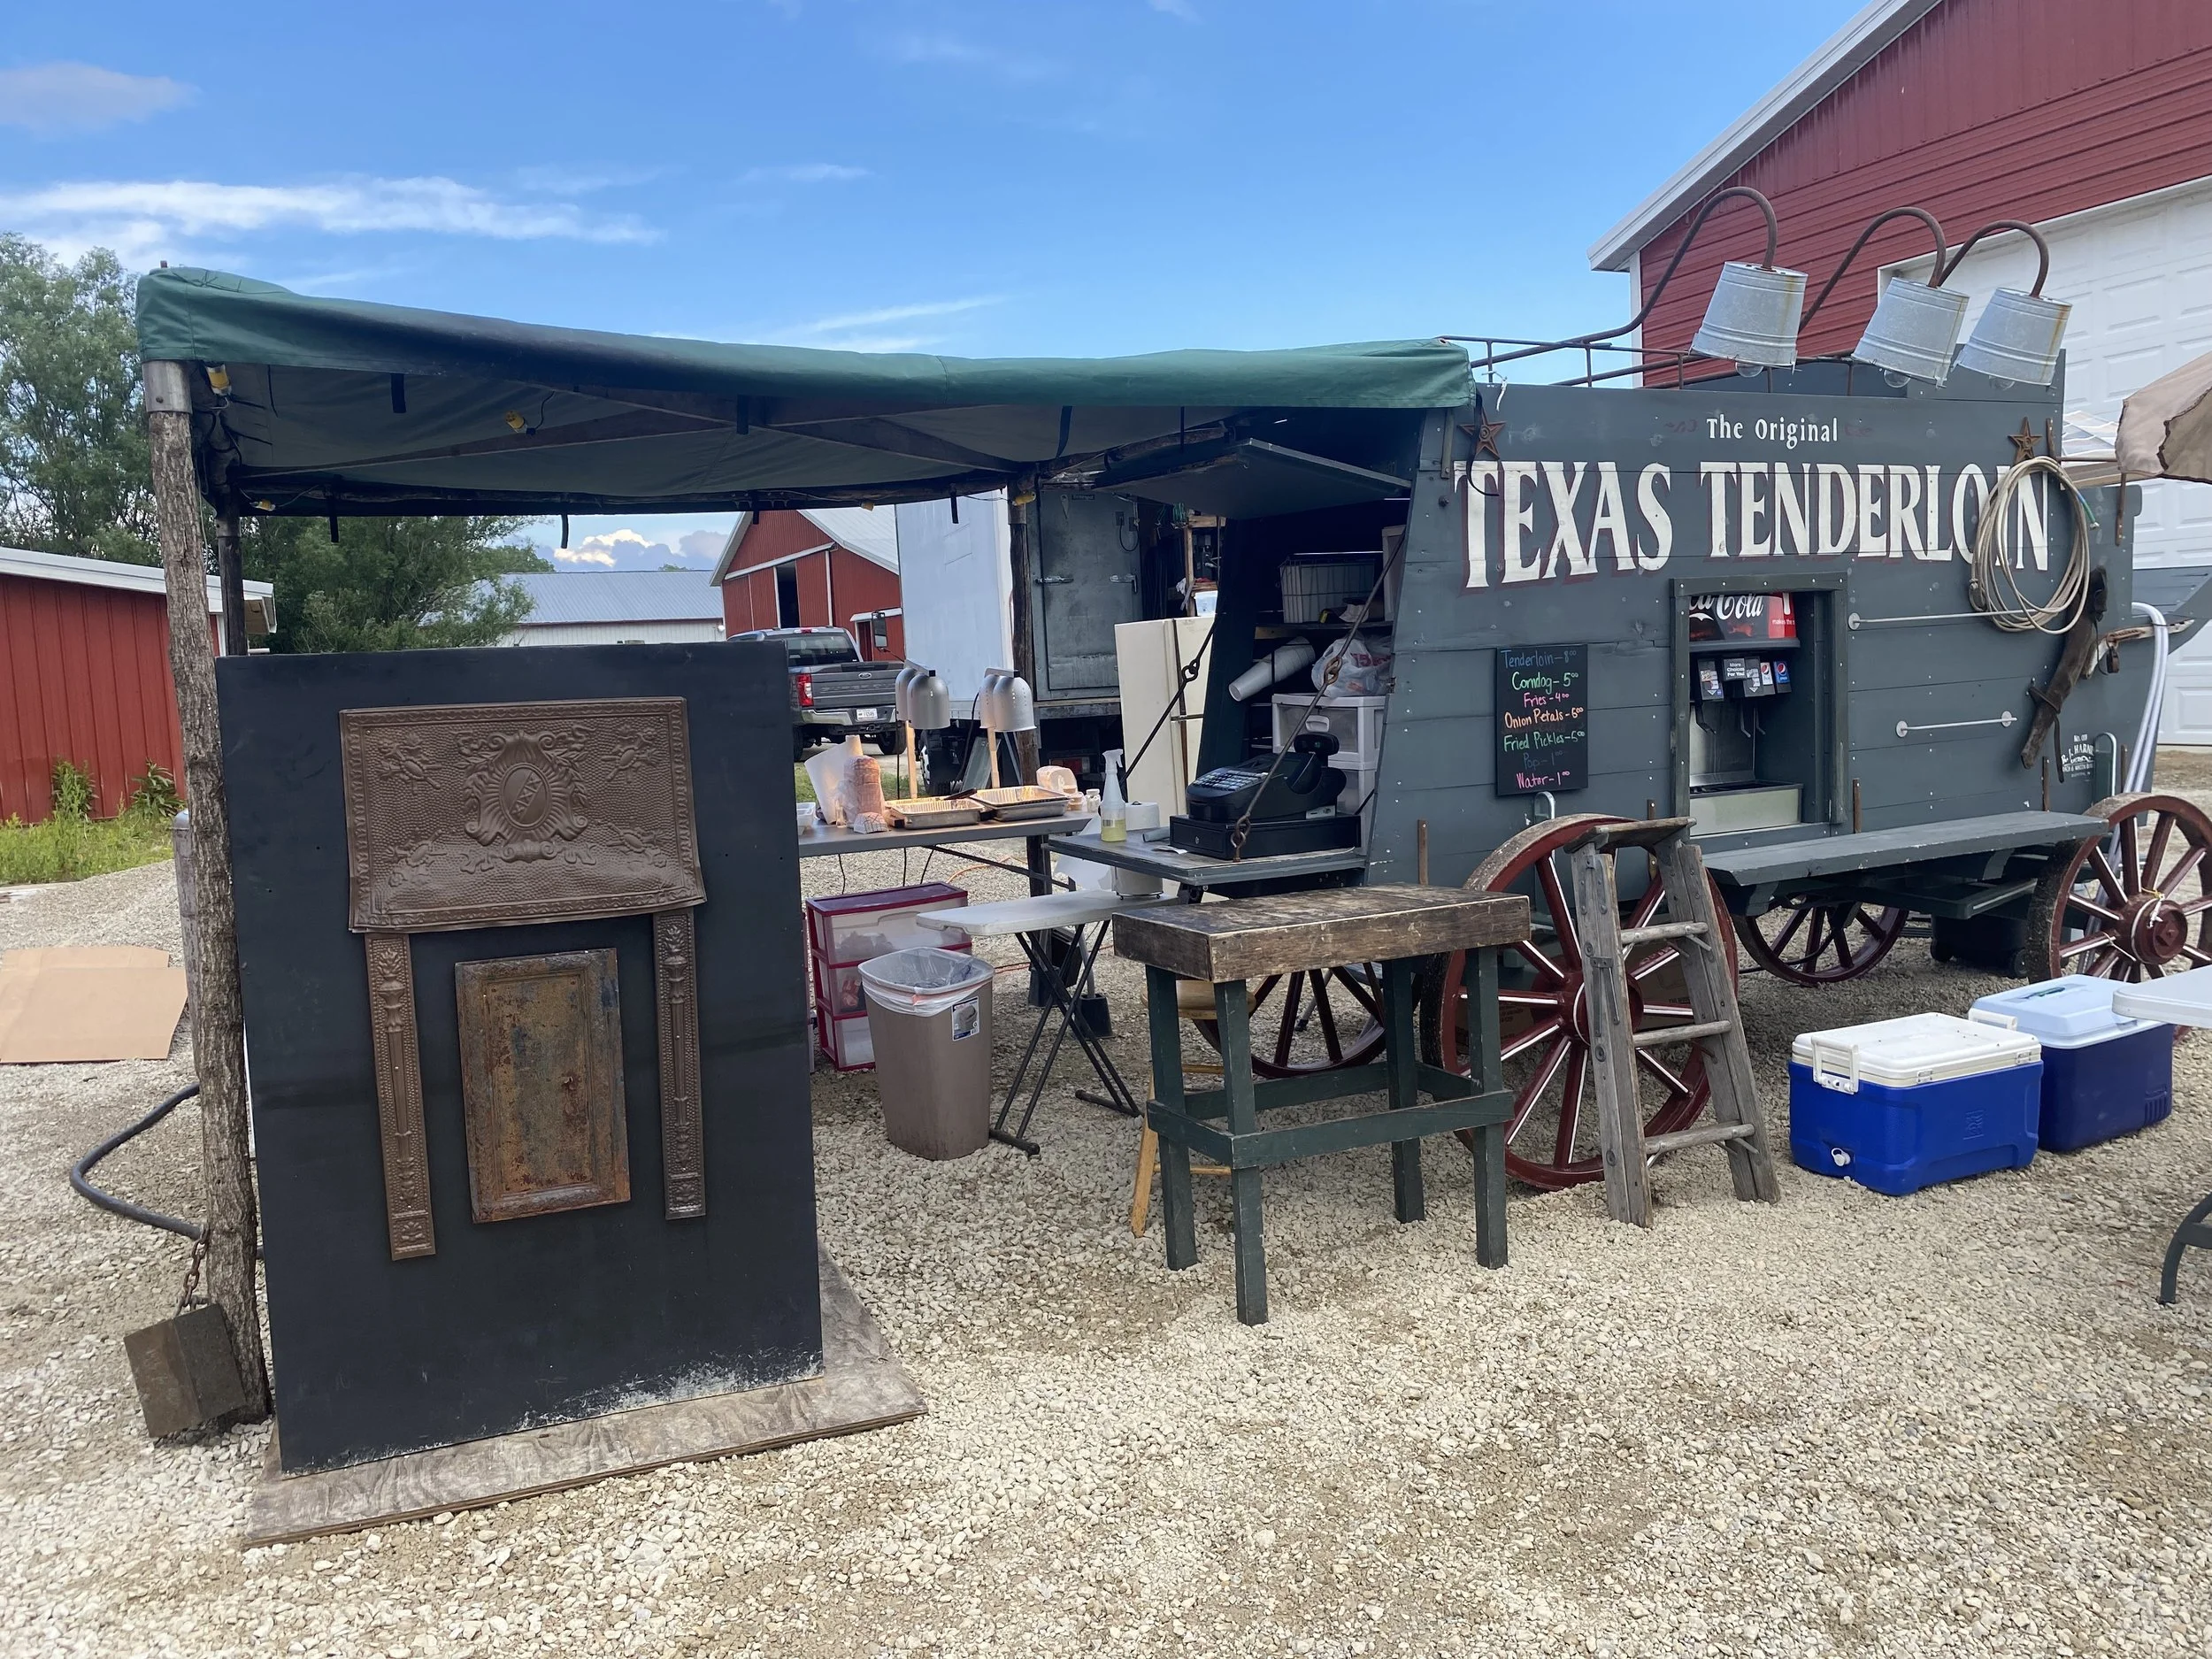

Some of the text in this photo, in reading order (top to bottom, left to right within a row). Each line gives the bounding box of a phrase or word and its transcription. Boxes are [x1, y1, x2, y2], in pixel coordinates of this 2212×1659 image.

[1707, 414, 1838, 449] The Original
[1454, 461, 1671, 588] TEXAS
[1501, 649, 1554, 669] Tenderloin
[1511, 672, 1553, 695] Corndog
[1524, 692, 1547, 709] Fries
[1504, 711, 1532, 729] Onion
[1532, 708, 1563, 725] Petals
[1503, 733, 1530, 752] Fried
[1533, 731, 1564, 749] Pickles
[1523, 751, 1540, 771] Pop
[1516, 772, 1548, 789] Water
